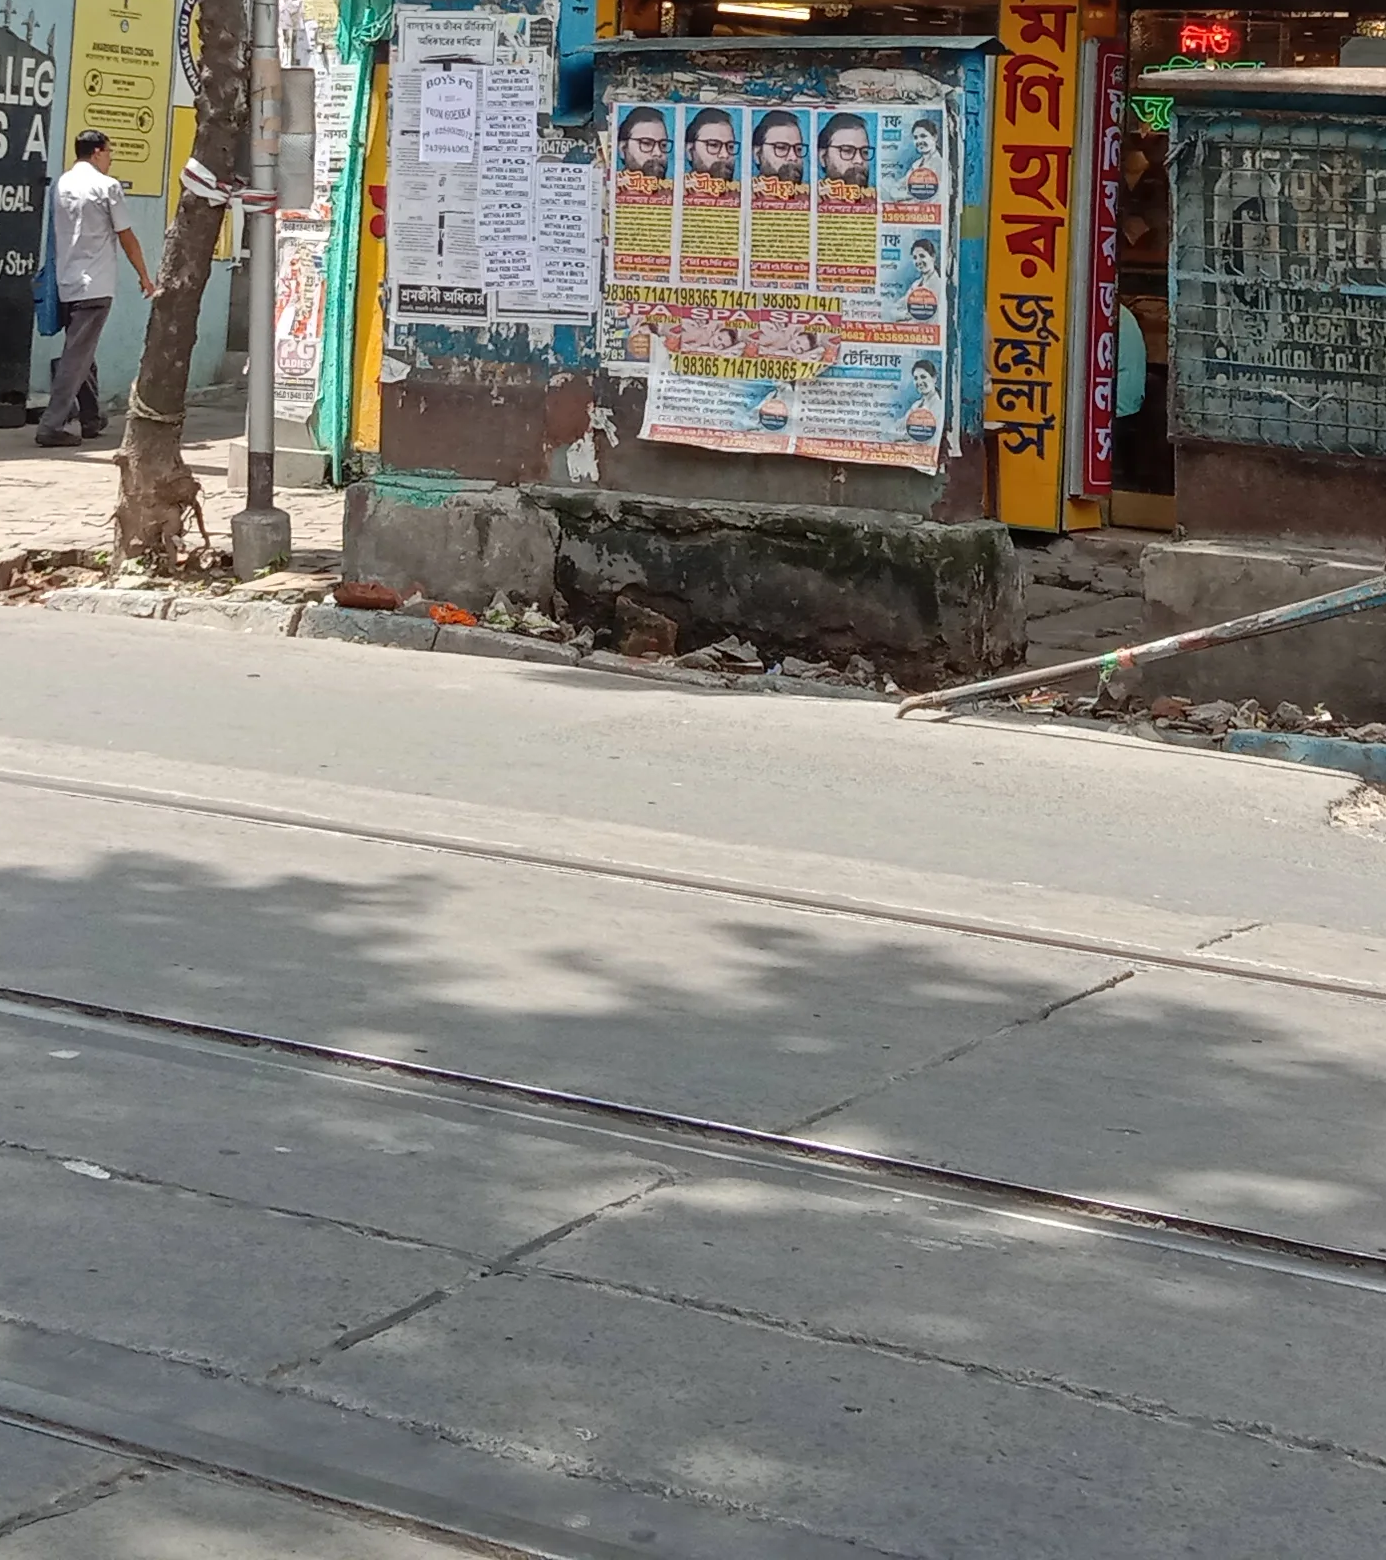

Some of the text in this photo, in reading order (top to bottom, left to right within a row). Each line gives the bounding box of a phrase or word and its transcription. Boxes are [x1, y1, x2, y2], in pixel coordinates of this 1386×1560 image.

[1180, 24, 1231, 54] নিউ
[179, 15, 202, 93] THANK YOU
[426, 75, 473, 90] BOY'S PG
[21, 113, 48, 162] A
[999, 4, 1077, 279] মণিহার
[444, 289, 486, 307] অধিকার
[603, 284, 640, 301] 98365
[690, 306, 753, 322] SPA
[769, 310, 831, 326] SPA
[280, 339, 316, 360] PG
[280, 358, 313, 369] LADIES
[682, 358, 719, 378] 98365
[992, 292, 1061, 460] জুয়েলার্স
